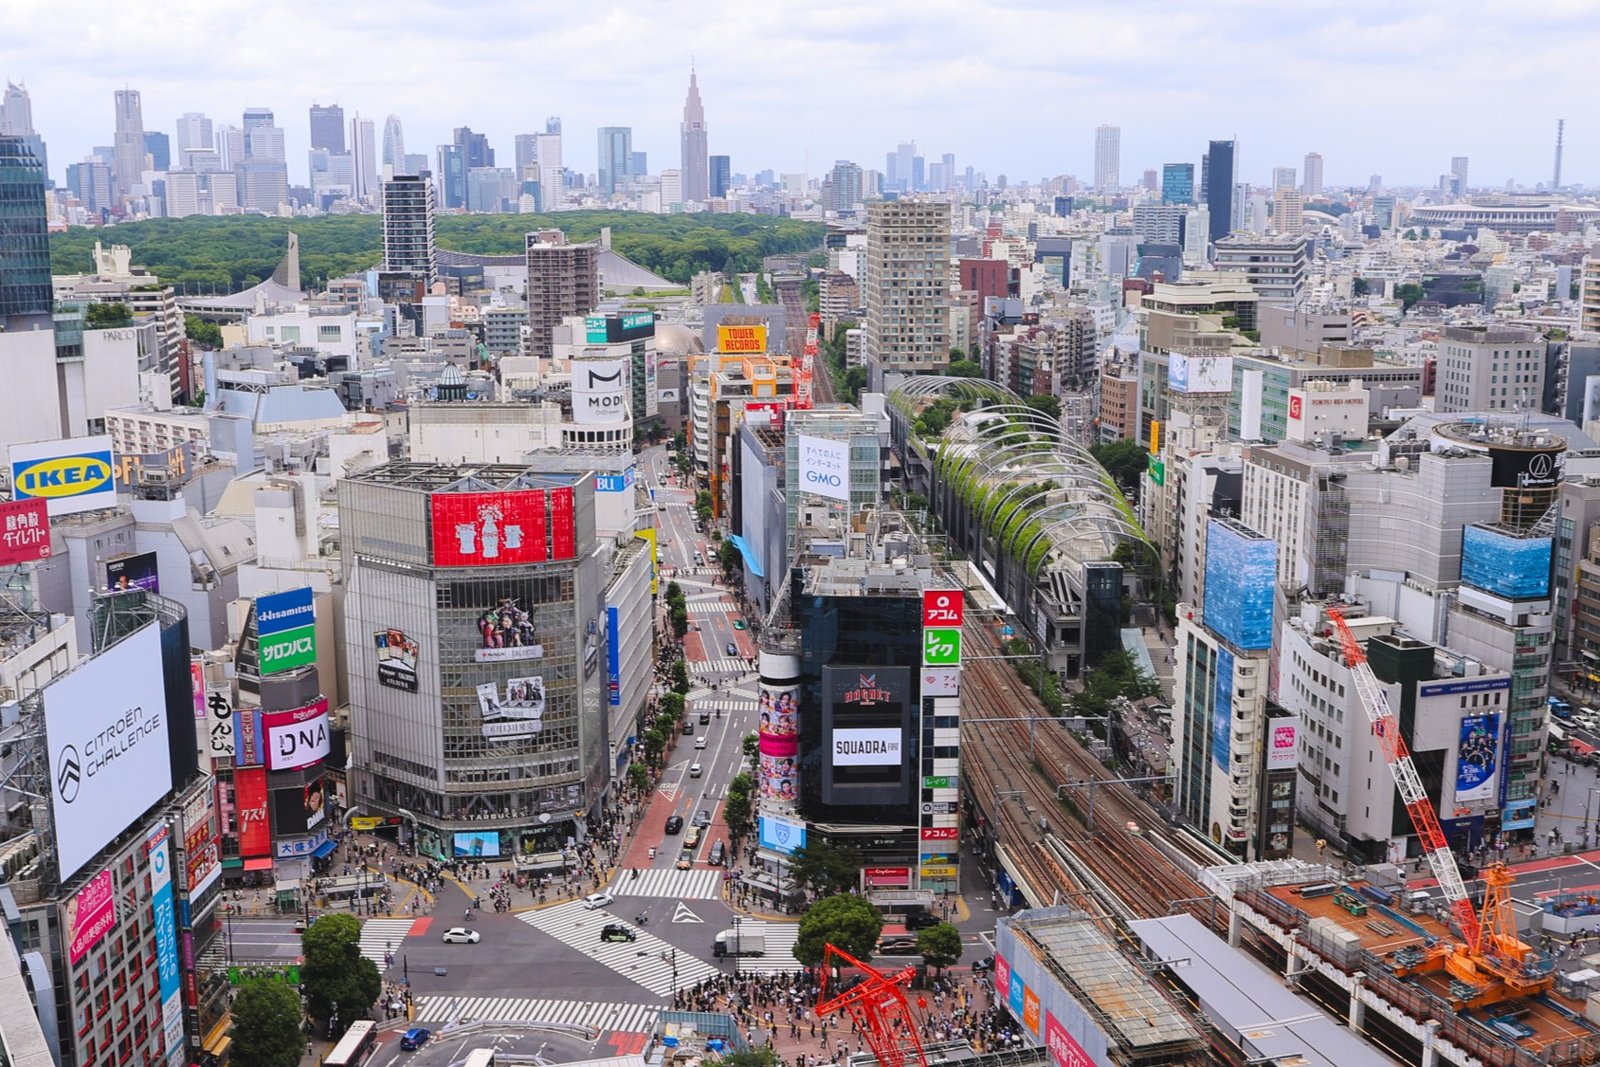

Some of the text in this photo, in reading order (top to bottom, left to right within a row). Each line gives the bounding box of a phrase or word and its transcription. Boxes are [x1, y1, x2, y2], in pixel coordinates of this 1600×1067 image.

[103, 329, 136, 341] PARCO
[728, 328, 755, 339] TOWER
[725, 338, 760, 351] RECORDS
[588, 395, 623, 407] MODI
[25, 464, 105, 490] IKEA
[806, 470, 841, 487] GMO
[258, 603, 313, 622] Hisamitsu
[928, 610, 958, 619] アコム
[263, 636, 313, 661] サロンパス
[926, 631, 954, 657] レイク
[293, 708, 318, 720] Rakuten
[208, 691, 234, 754] もんじゃ
[84, 705, 143, 758] CITROËN
[86, 713, 161, 778] CHALLENGE
[836, 740, 887, 755] SQUADRA
[462, 811, 525, 821] STARBUCKS
